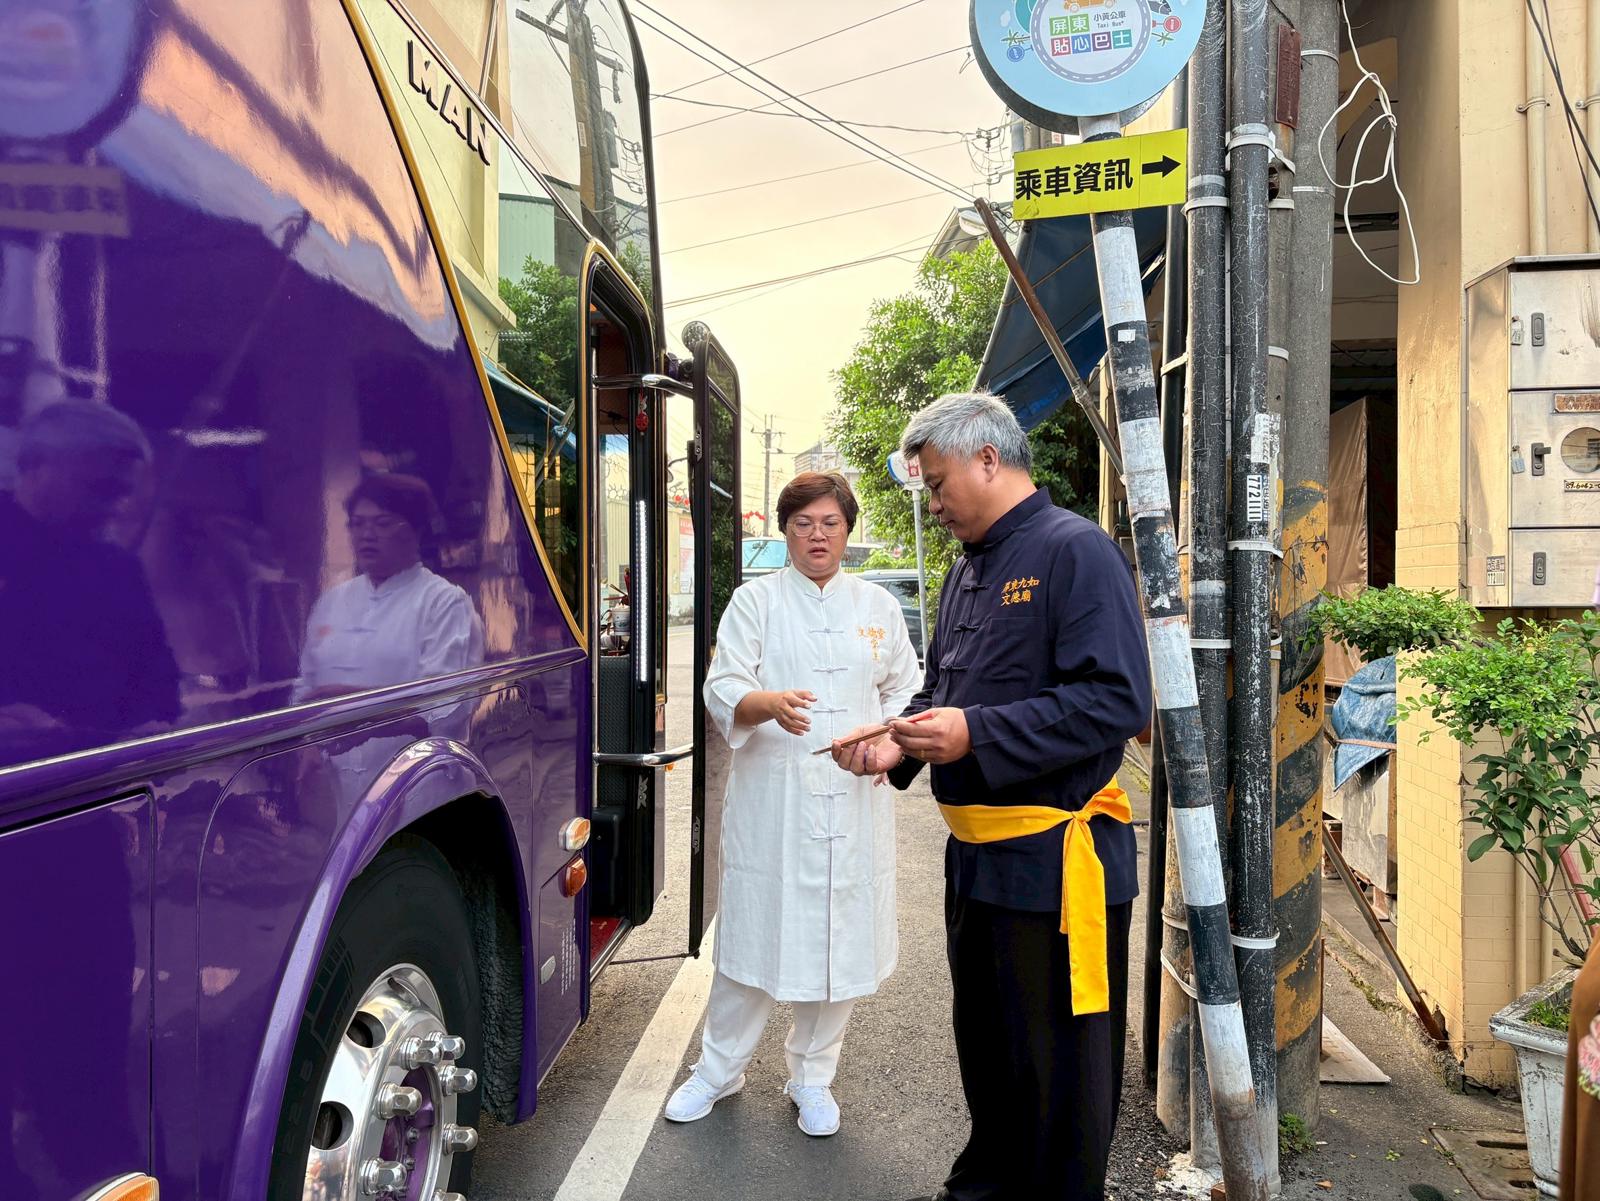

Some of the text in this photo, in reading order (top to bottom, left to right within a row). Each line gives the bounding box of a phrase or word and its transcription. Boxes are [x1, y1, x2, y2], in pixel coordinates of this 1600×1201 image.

[1052, 16, 1088, 34] 屏東
[1093, 11, 1126, 22] 小黃公車
[1053, 32, 1130, 54] 貼心巴士
[407, 40, 491, 166] MAN
[1015, 158, 1133, 201] 乘車資訊
[1248, 476, 1262, 520] 7721111
